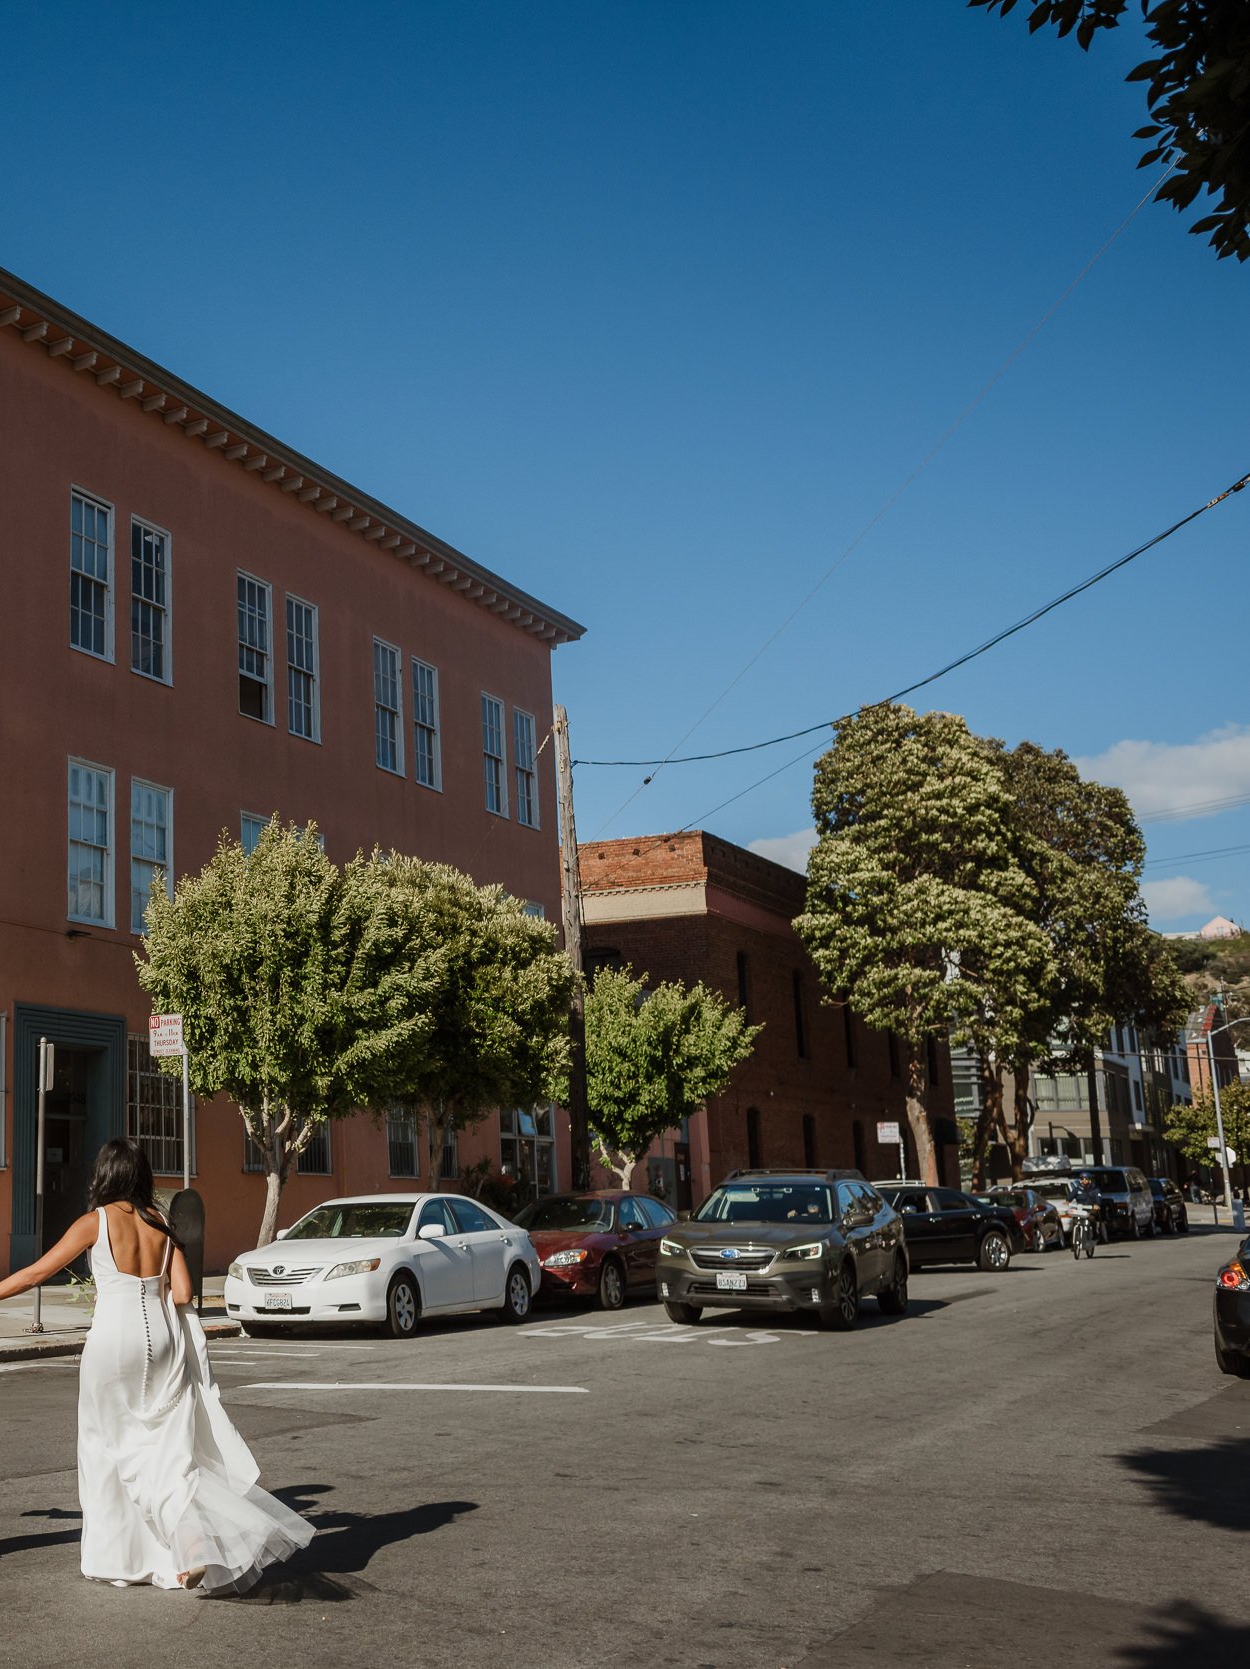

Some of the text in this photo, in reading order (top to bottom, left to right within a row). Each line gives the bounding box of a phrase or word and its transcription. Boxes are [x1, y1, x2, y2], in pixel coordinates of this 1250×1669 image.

[150, 1017, 181, 1028] NO PARKING
[154, 1038, 179, 1047] THURSDAY
[516, 1322, 819, 1346] STOP
